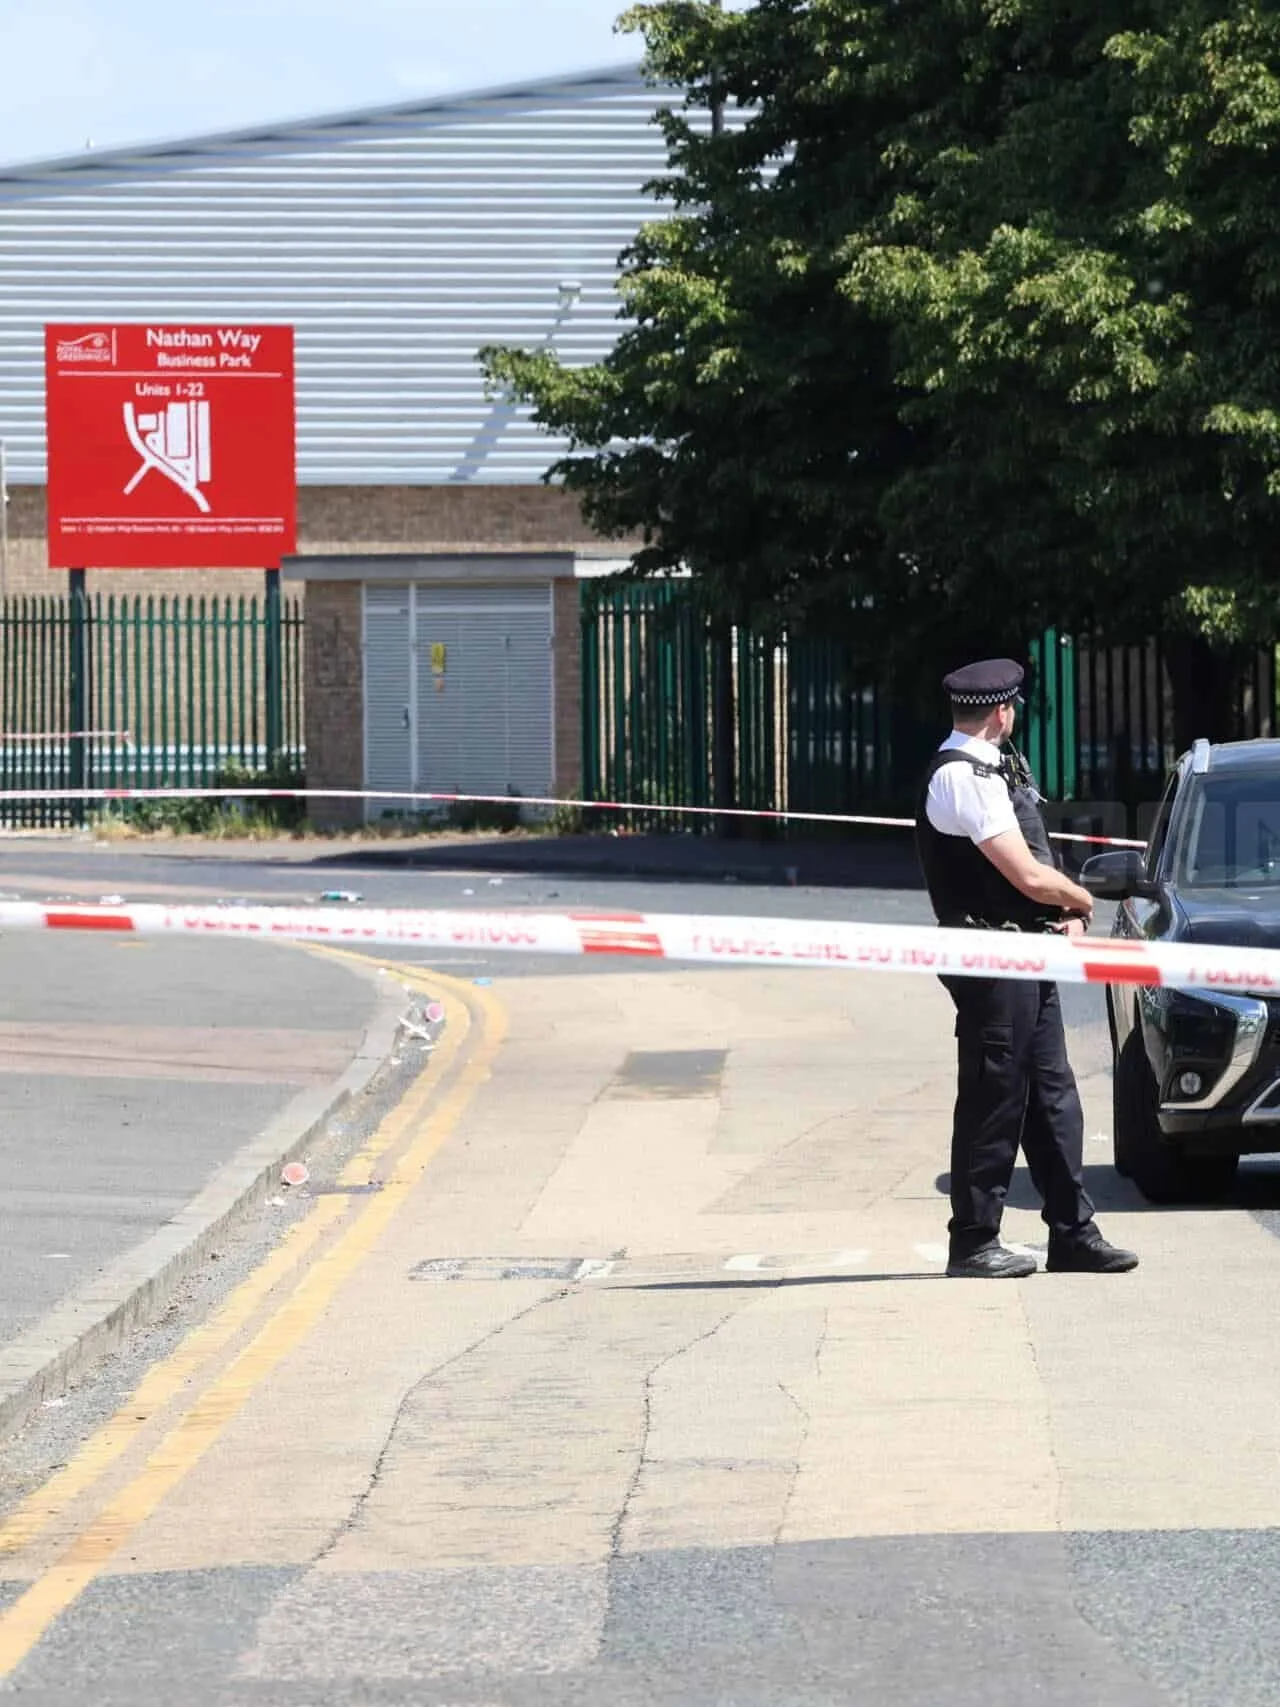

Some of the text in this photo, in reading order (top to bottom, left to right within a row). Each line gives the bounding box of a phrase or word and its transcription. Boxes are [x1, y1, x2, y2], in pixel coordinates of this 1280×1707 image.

[146, 328, 262, 353] Nathan Way
[156, 352, 253, 368] Business Park
[135, 382, 205, 397] Units 1-22
